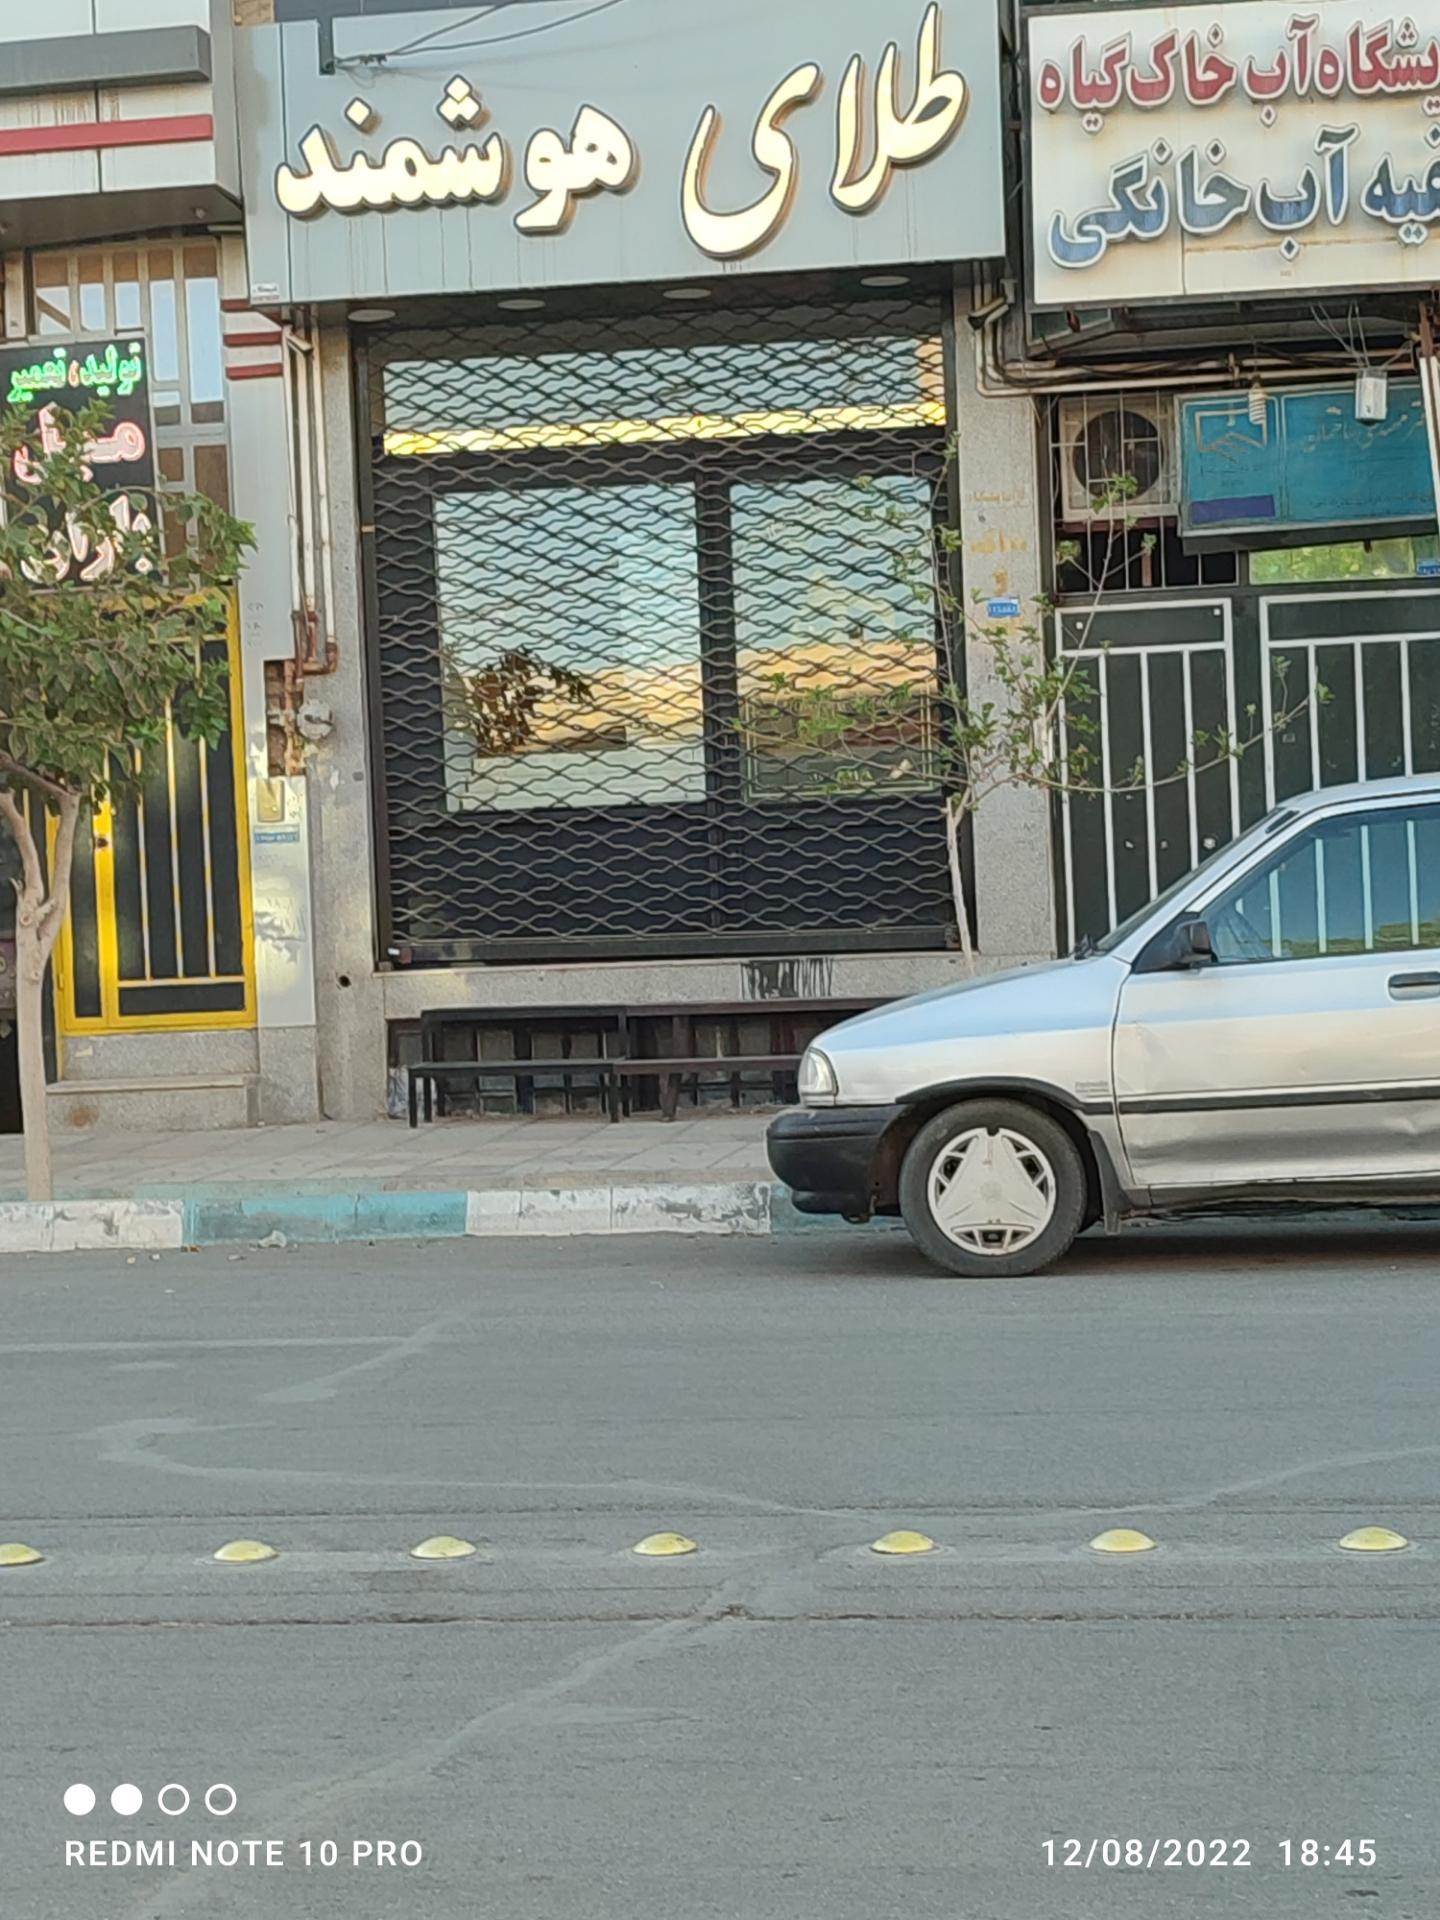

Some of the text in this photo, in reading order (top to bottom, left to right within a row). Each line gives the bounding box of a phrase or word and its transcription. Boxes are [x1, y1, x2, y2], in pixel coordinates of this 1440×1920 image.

[1038, 33, 1132, 132] گیاه
[1126, 25, 1238, 107] خاک
[1243, 14, 1319, 126] آب
[274, 2, 968, 260] طلای هوشمند
[1049, 138, 1251, 268] خانگی
[1255, 123, 1358, 260] آب
[7, 347, 67, 403] تعمیر
